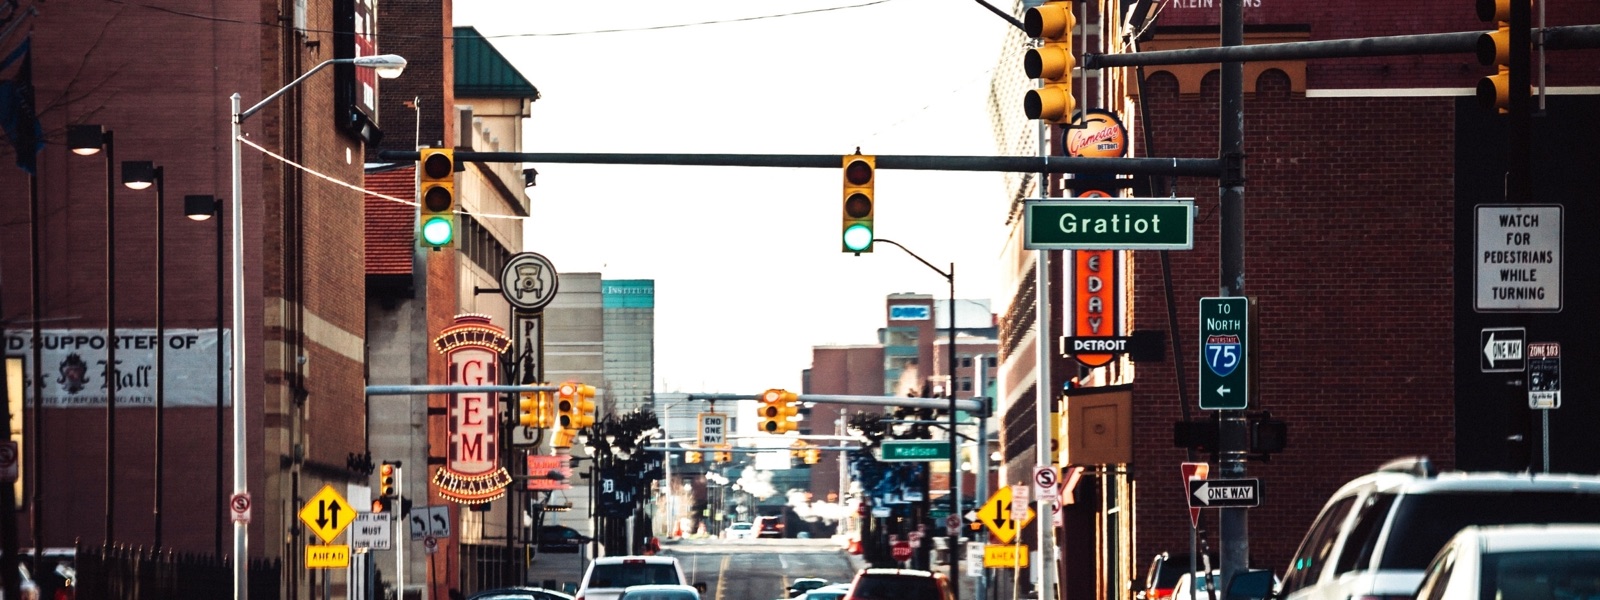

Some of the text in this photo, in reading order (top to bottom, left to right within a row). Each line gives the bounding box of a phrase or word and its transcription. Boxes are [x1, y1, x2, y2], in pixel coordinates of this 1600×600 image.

[1070, 124, 1119, 157] Gameday
[1059, 212, 1161, 234] Gratiot
[1499, 214, 1539, 227] WATCH
[1506, 232, 1531, 245] FOR
[1483, 250, 1553, 264] PEDESTRIANS
[1500, 268, 1537, 282] WHILE
[1087, 255, 1103, 334] EDAY
[1492, 286, 1545, 300] TURNING
[1217, 303, 1231, 315] TO
[1207, 317, 1241, 331] NORTH
[169, 335, 199, 350] OF
[443, 331, 499, 348] LITTLE
[1074, 339, 1127, 351] DETROIT
[1208, 345, 1237, 368] 75
[1493, 342, 1520, 358] ONE WAY
[1529, 345, 1558, 357] ZONE 103
[461, 360, 483, 462] GEM
[894, 446, 938, 457] Madison
[440, 473, 500, 492] THEATRE
[1208, 487, 1251, 499] ONE WAY
[362, 527, 381, 535] MUST
[312, 552, 344, 561] AHEAD
